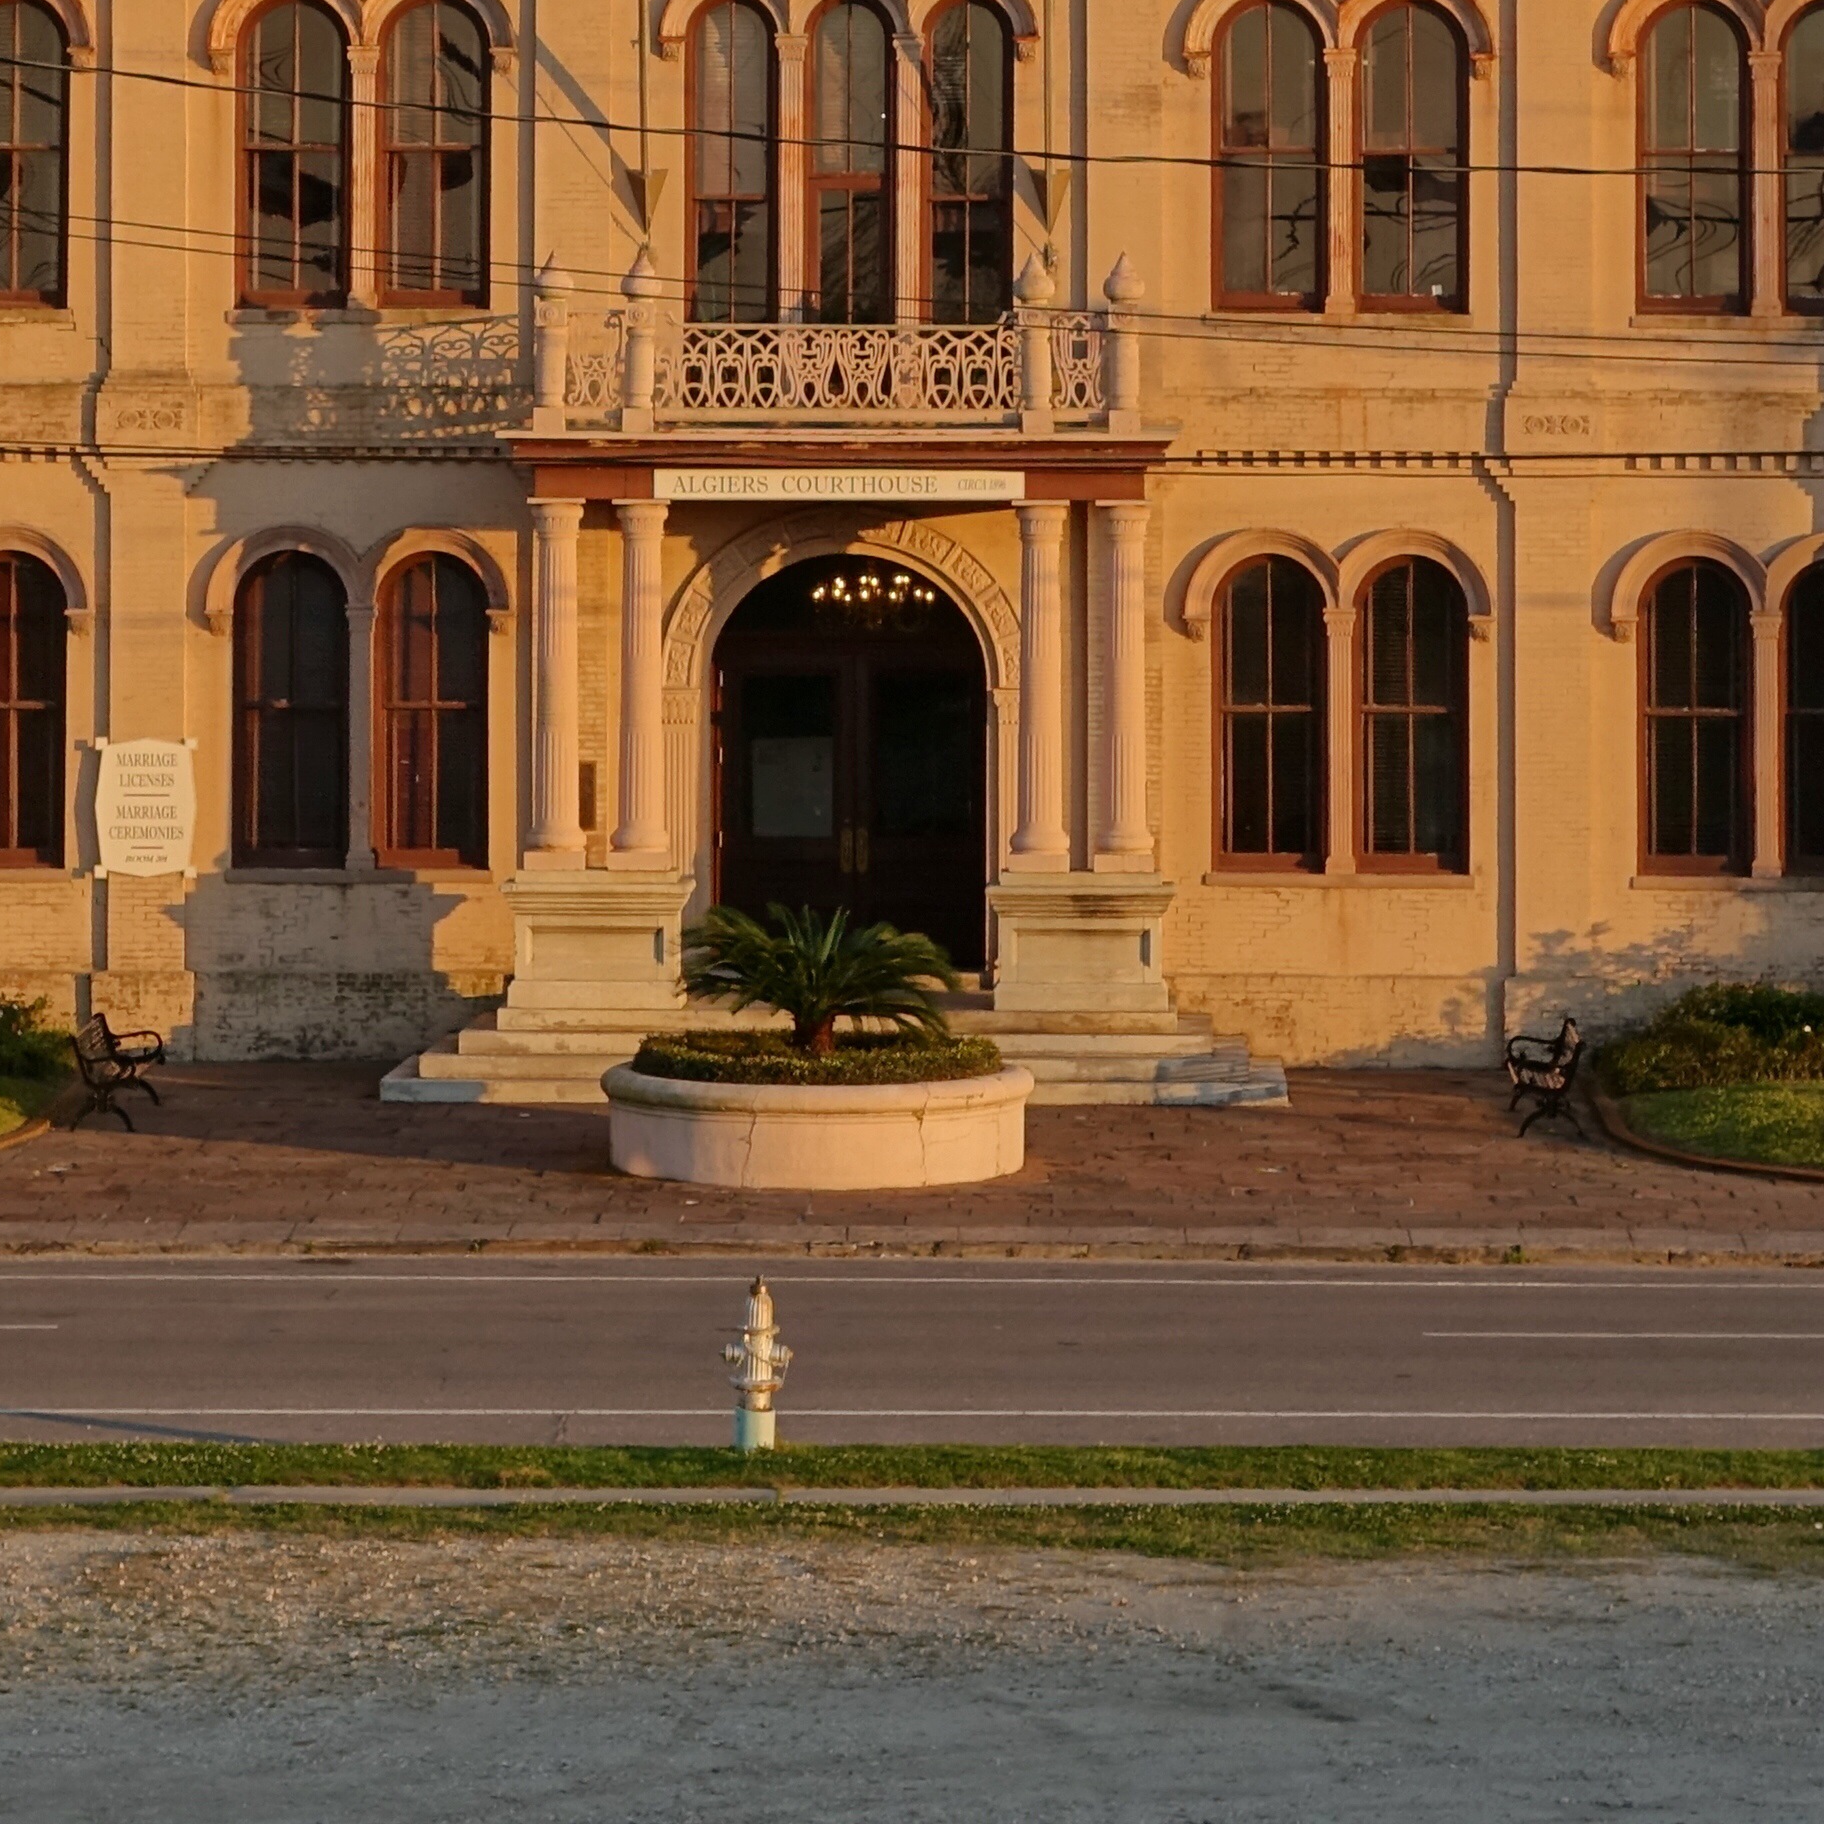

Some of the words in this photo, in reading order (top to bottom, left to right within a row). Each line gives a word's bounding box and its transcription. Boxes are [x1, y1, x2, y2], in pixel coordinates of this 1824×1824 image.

[672, 474, 769, 494] ALGIERS
[781, 474, 938, 494] COURTHOUSE
[958, 478, 986, 490] CIRCA
[116, 753, 178, 767] MARRIAGE
[119, 773, 175, 787] LICENSES
[116, 805, 178, 819] MARRIAGE
[108, 825, 184, 840] CEREMONIES
